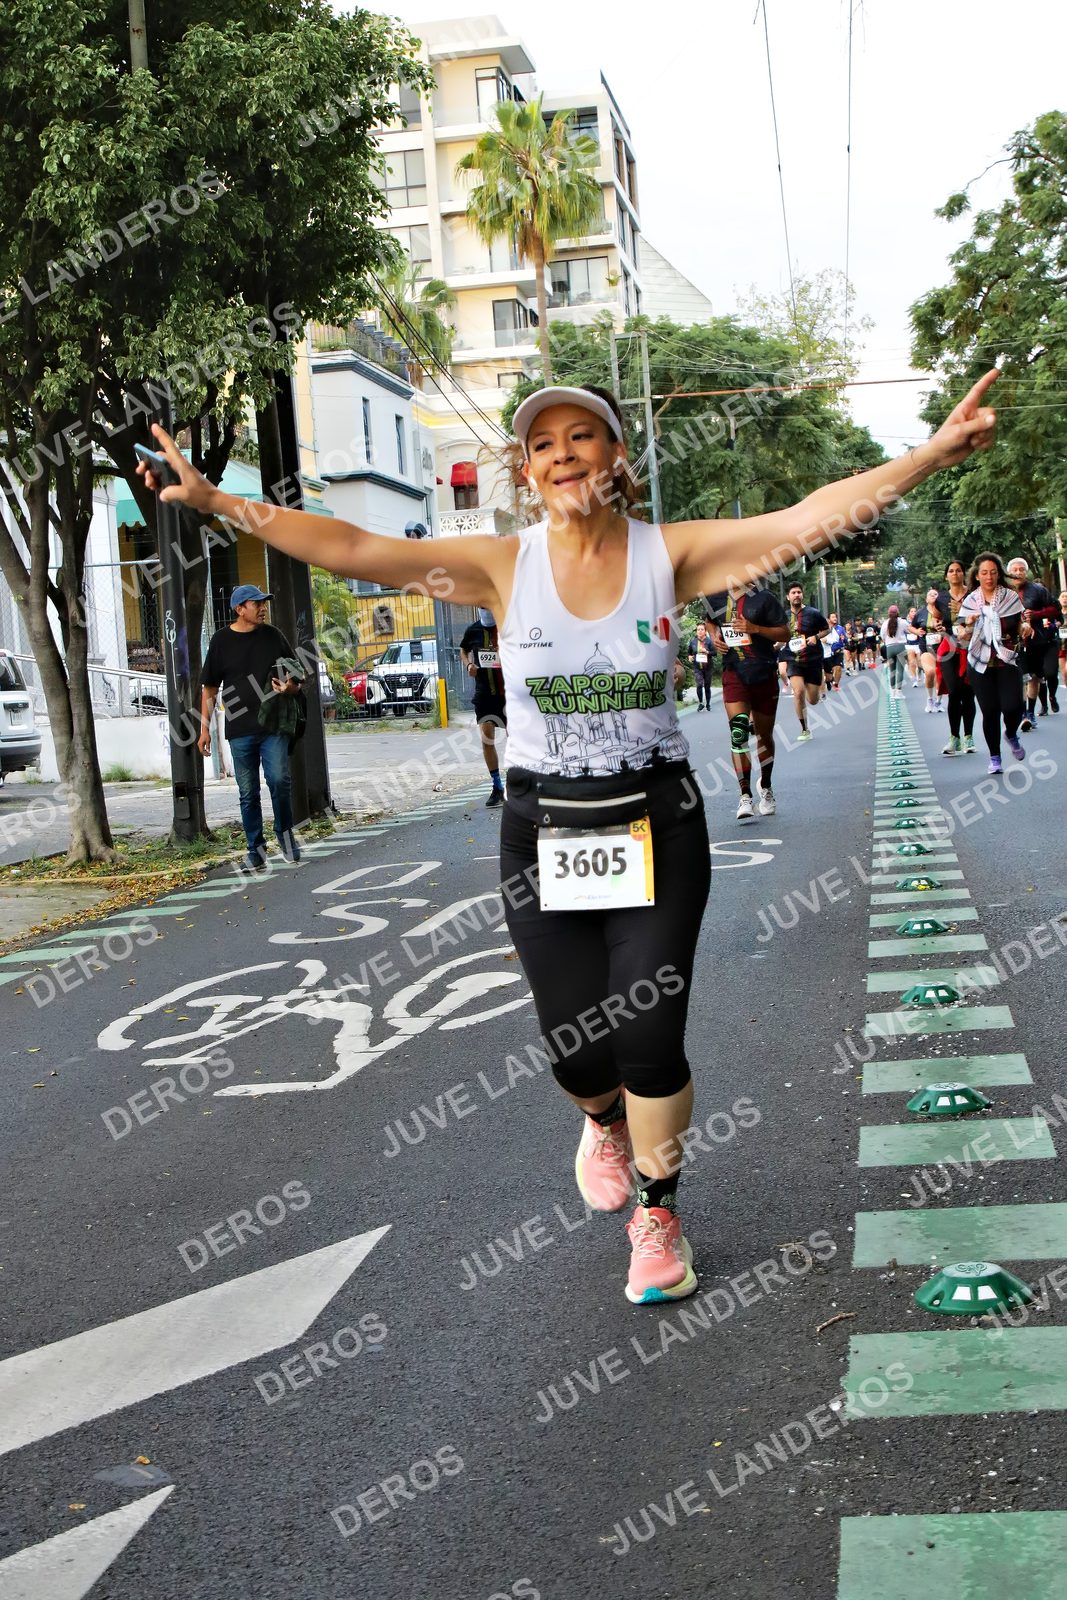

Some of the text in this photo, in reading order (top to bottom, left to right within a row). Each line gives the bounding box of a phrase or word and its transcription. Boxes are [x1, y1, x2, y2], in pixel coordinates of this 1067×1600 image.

[480, 653, 497, 661] 6924
[525, 670, 668, 696] ZAPOPAN
[535, 691, 667, 715] RUNNERS
[632, 823, 646, 833] 5K
[554, 847, 627, 879] 3605
